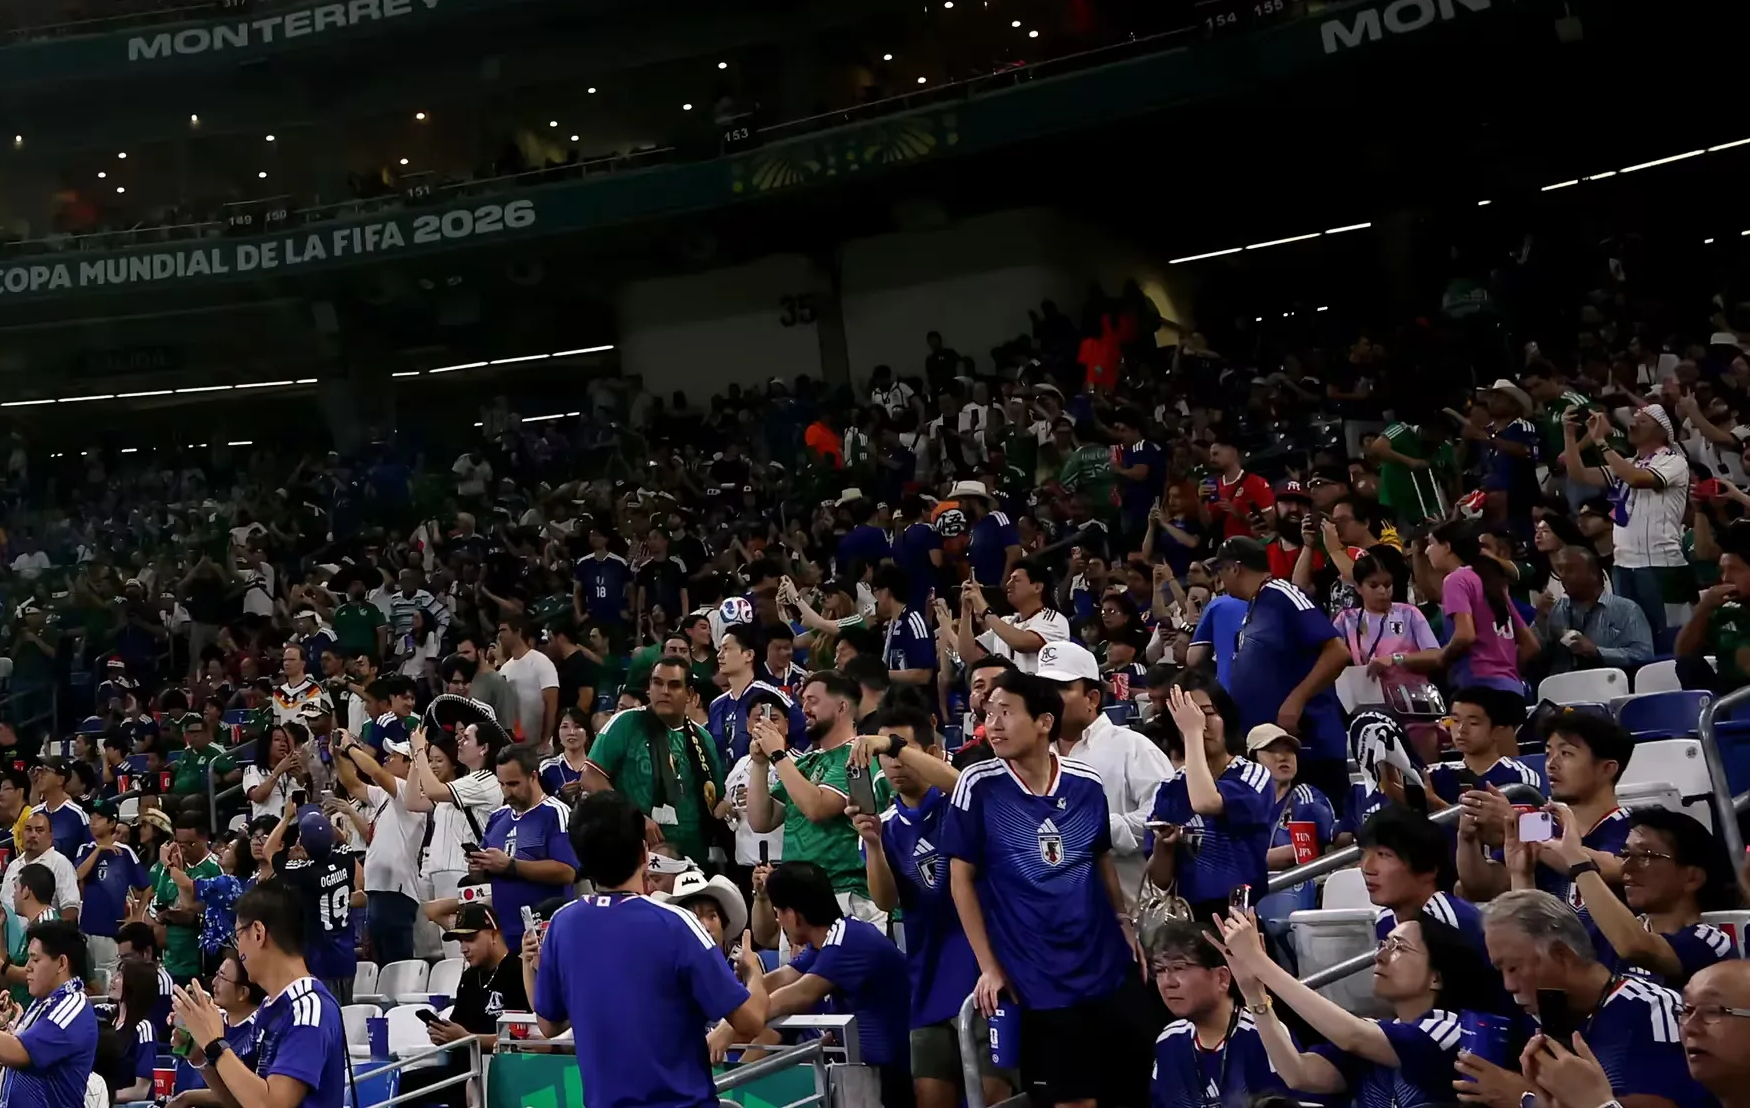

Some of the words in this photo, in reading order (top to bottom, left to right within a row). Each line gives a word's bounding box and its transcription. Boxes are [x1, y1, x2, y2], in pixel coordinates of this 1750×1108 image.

[1206, 12, 1236, 30] 154
[725, 127, 749, 142] 153
[408, 186, 430, 198] 151
[80, 248, 229, 286] MUNDIAL
[236, 242, 278, 272] DE
[285, 238, 327, 265] LA
[333, 221, 405, 257] FIFA
[412, 199, 537, 244] 2026
[778, 295, 816, 327] 35
[595, 586, 607, 598] 18
[1295, 832, 1311, 842] TUN
[1299, 846, 1312, 858] JPN
[320, 867, 348, 888] OGAWA
[319, 884, 350, 931] 19
